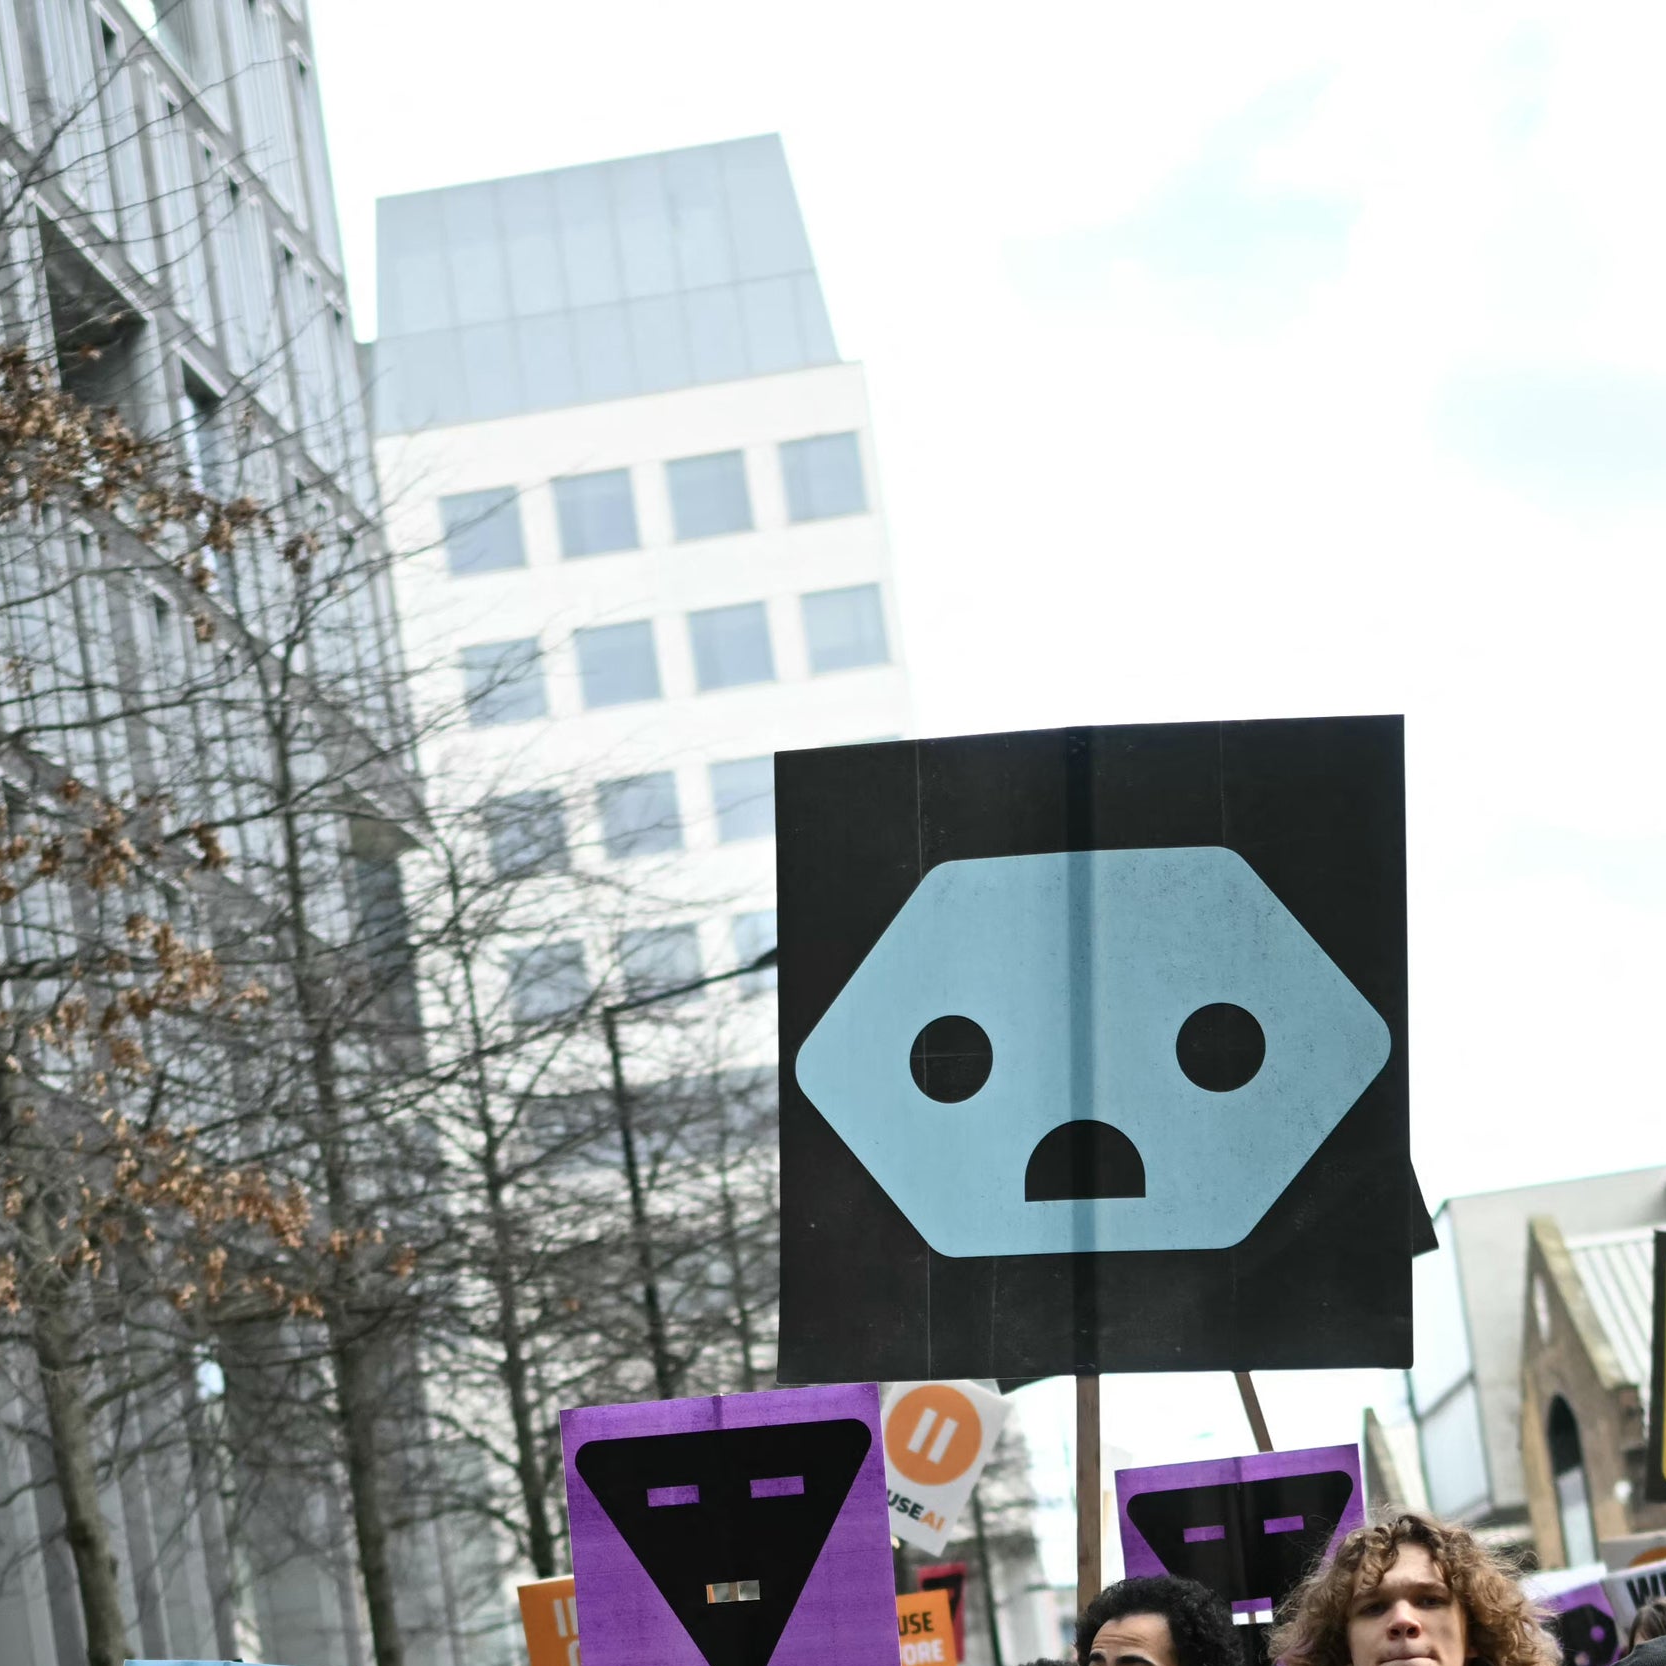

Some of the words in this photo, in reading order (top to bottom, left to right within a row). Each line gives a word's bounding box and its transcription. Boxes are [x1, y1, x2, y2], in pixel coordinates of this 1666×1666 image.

[887, 1489, 946, 1533] USEAI
[898, 1611, 934, 1636] USE
[902, 1637, 946, 1666] ORE
